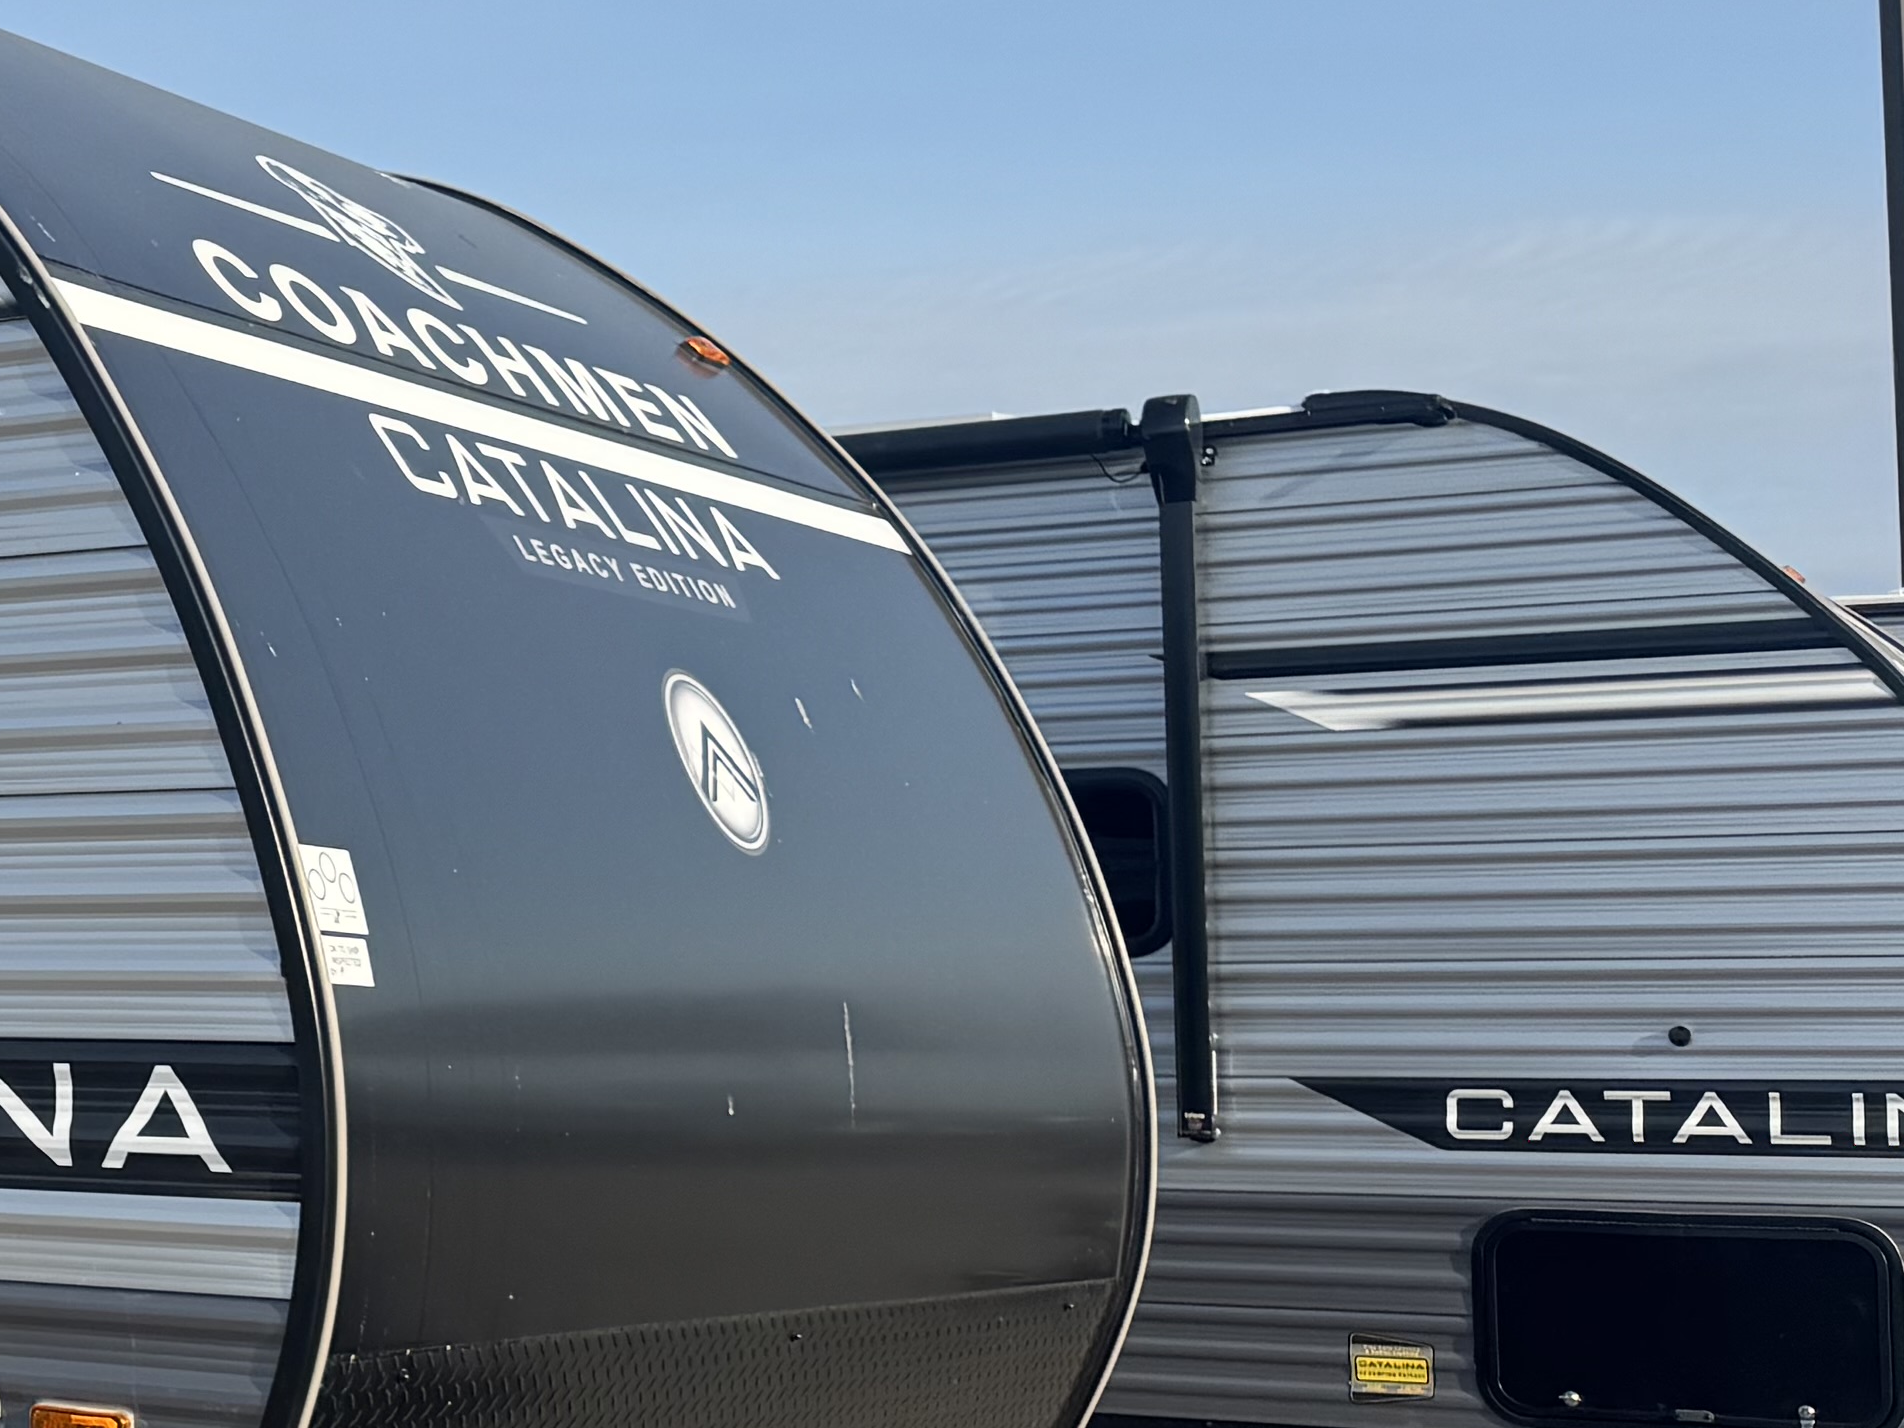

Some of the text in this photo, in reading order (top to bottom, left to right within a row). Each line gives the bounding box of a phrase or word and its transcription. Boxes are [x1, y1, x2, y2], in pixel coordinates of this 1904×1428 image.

[191, 238, 738, 459] COACHMEN
[368, 412, 781, 580] CATALINA
[512, 534, 737, 610] LEGACY EDITION
[1445, 1087, 1904, 1147] CATALI
[1358, 1359, 1425, 1371] CATALINA
